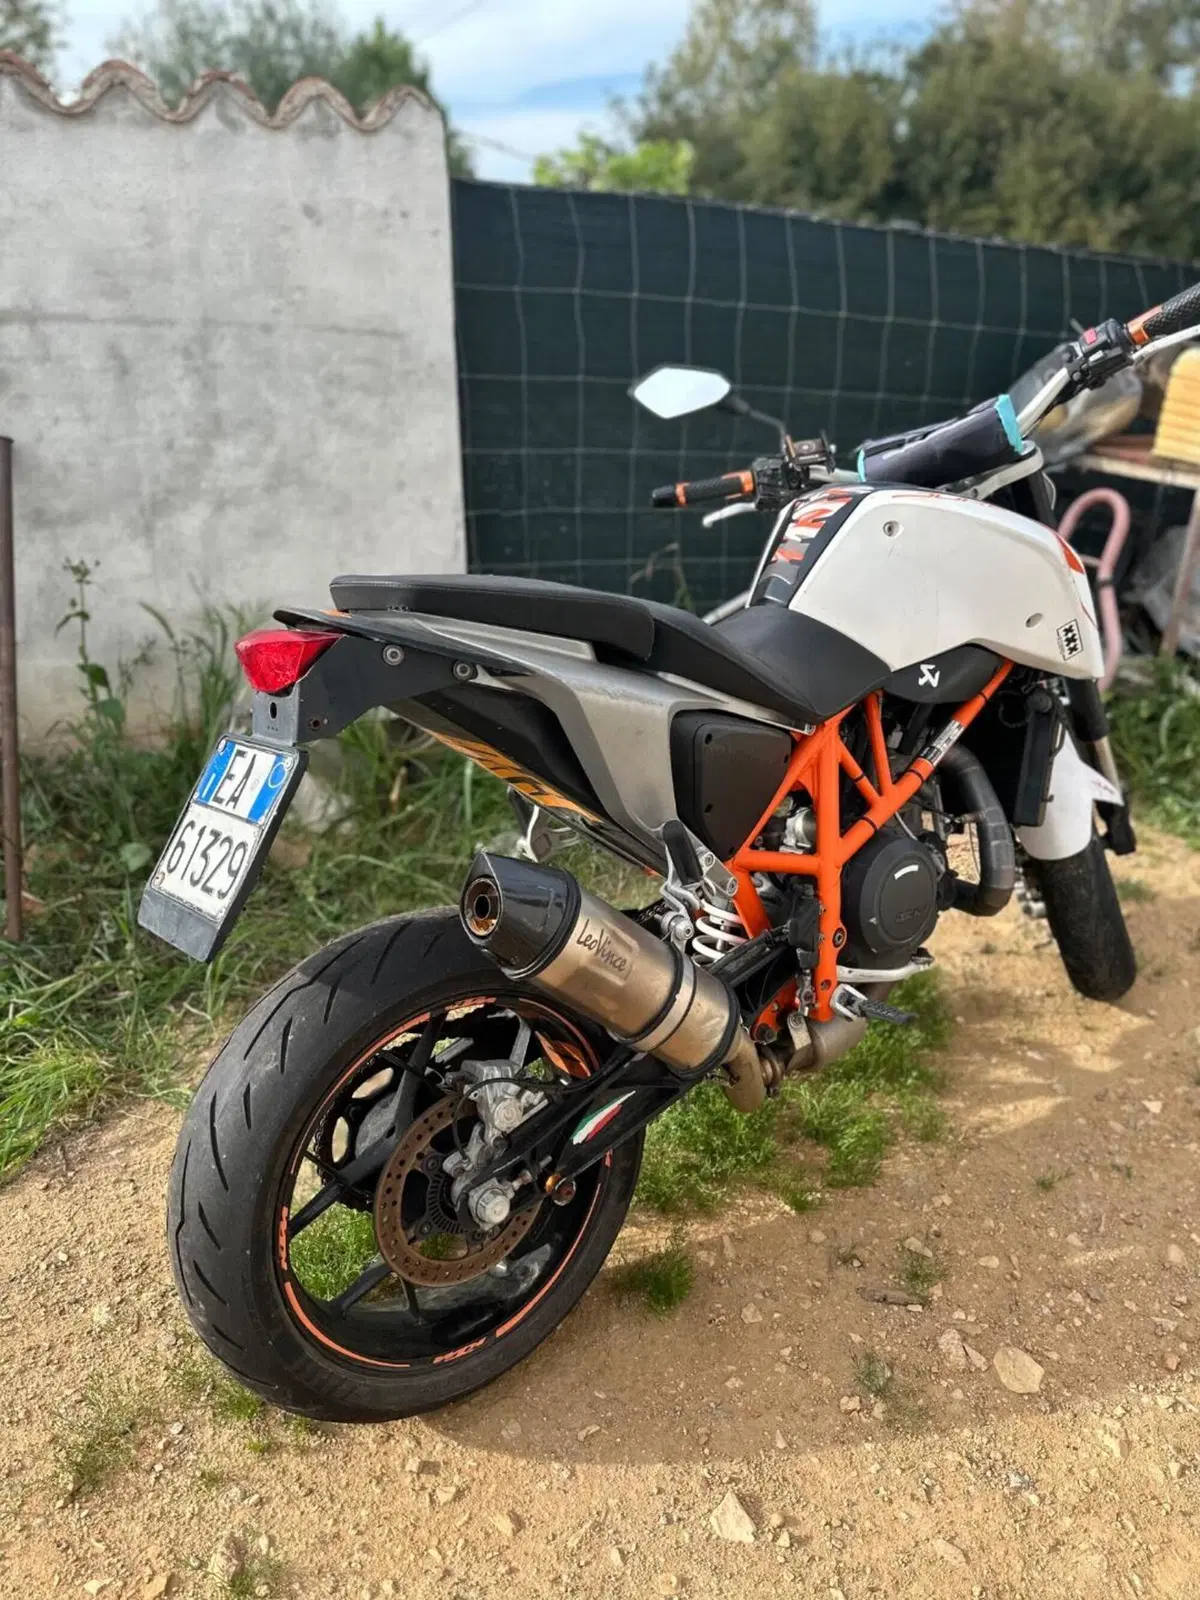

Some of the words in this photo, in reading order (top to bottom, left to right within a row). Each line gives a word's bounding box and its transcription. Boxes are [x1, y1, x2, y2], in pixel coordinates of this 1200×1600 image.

[212, 748, 257, 810] EA
[166, 819, 249, 900] 61329
[576, 918, 627, 972] LeoVince
